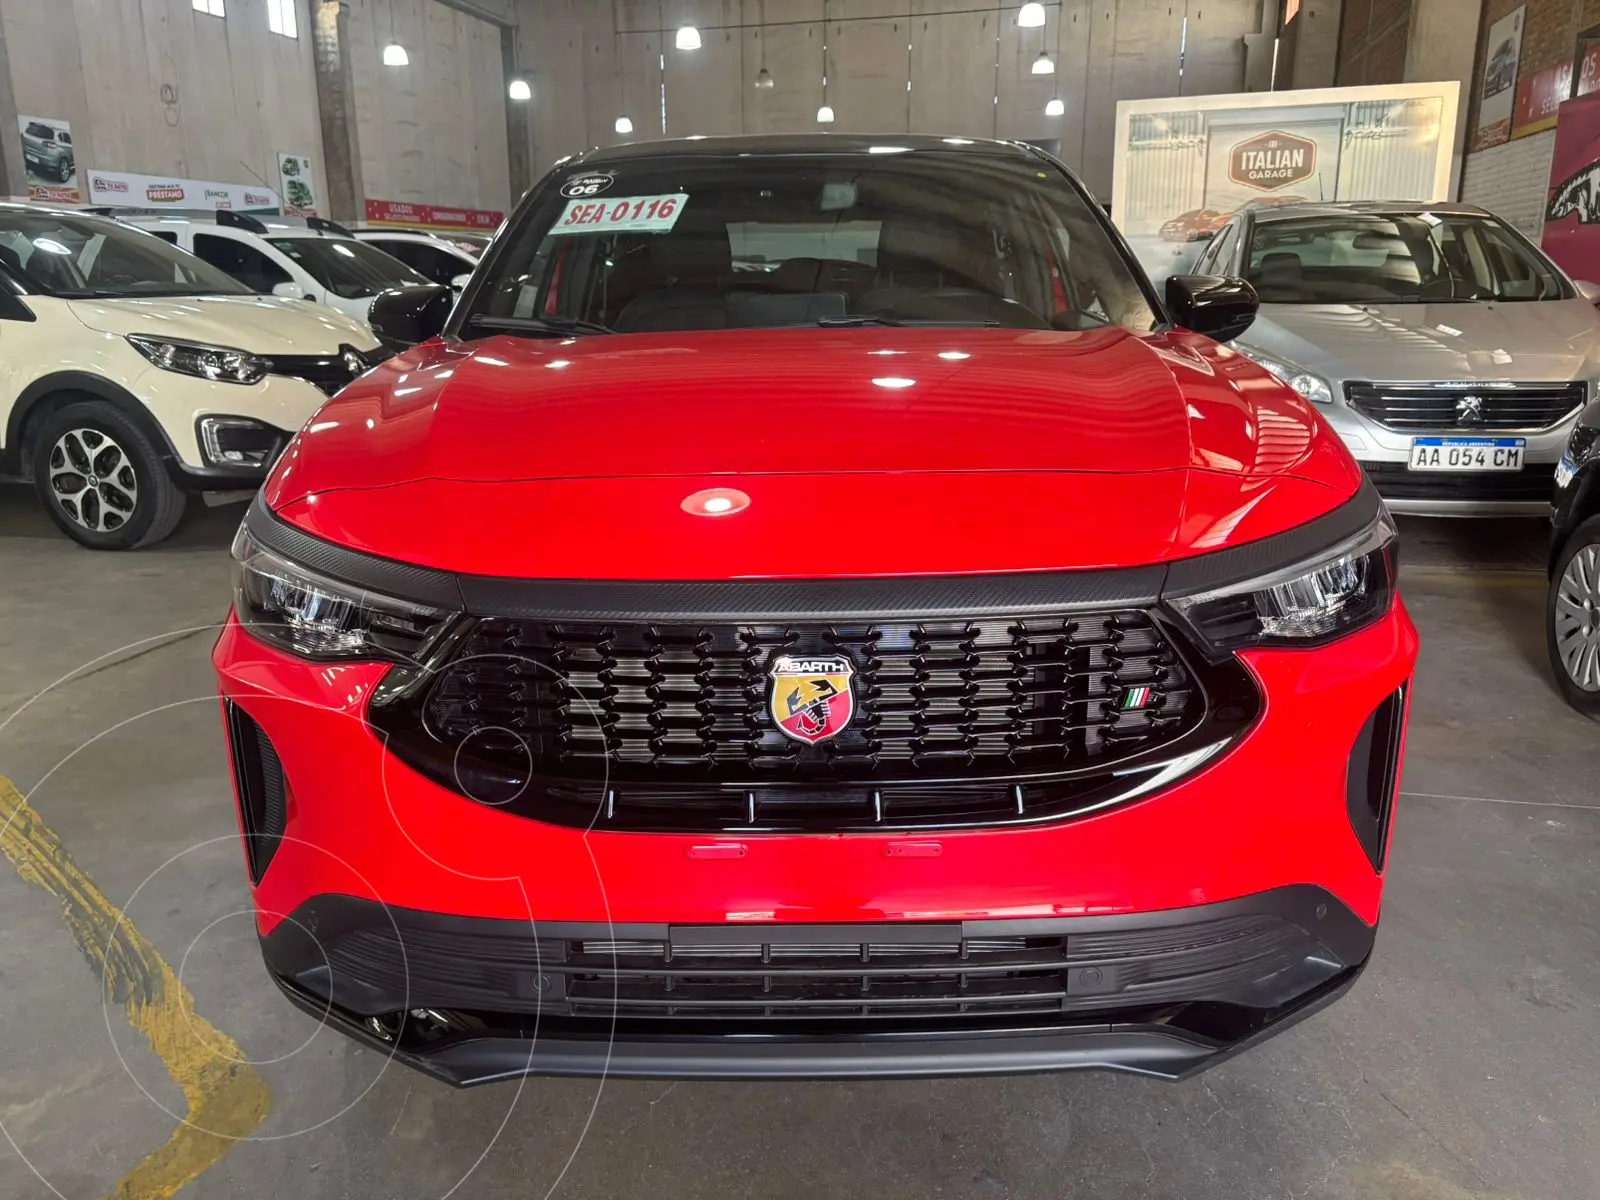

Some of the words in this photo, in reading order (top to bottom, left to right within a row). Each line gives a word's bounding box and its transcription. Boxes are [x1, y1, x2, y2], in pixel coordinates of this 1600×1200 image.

[1241, 148, 1304, 170] ITALIAN
[1248, 169, 1293, 179] GARAGE
[569, 185, 600, 195] 06
[388, 203, 413, 214] USADOS
[564, 199, 677, 225] SEA-0116
[1416, 448, 1440, 466] AA
[1449, 448, 1485, 467] 054
[1493, 449, 1518, 467] CM
[777, 661, 844, 672] ABARTH
